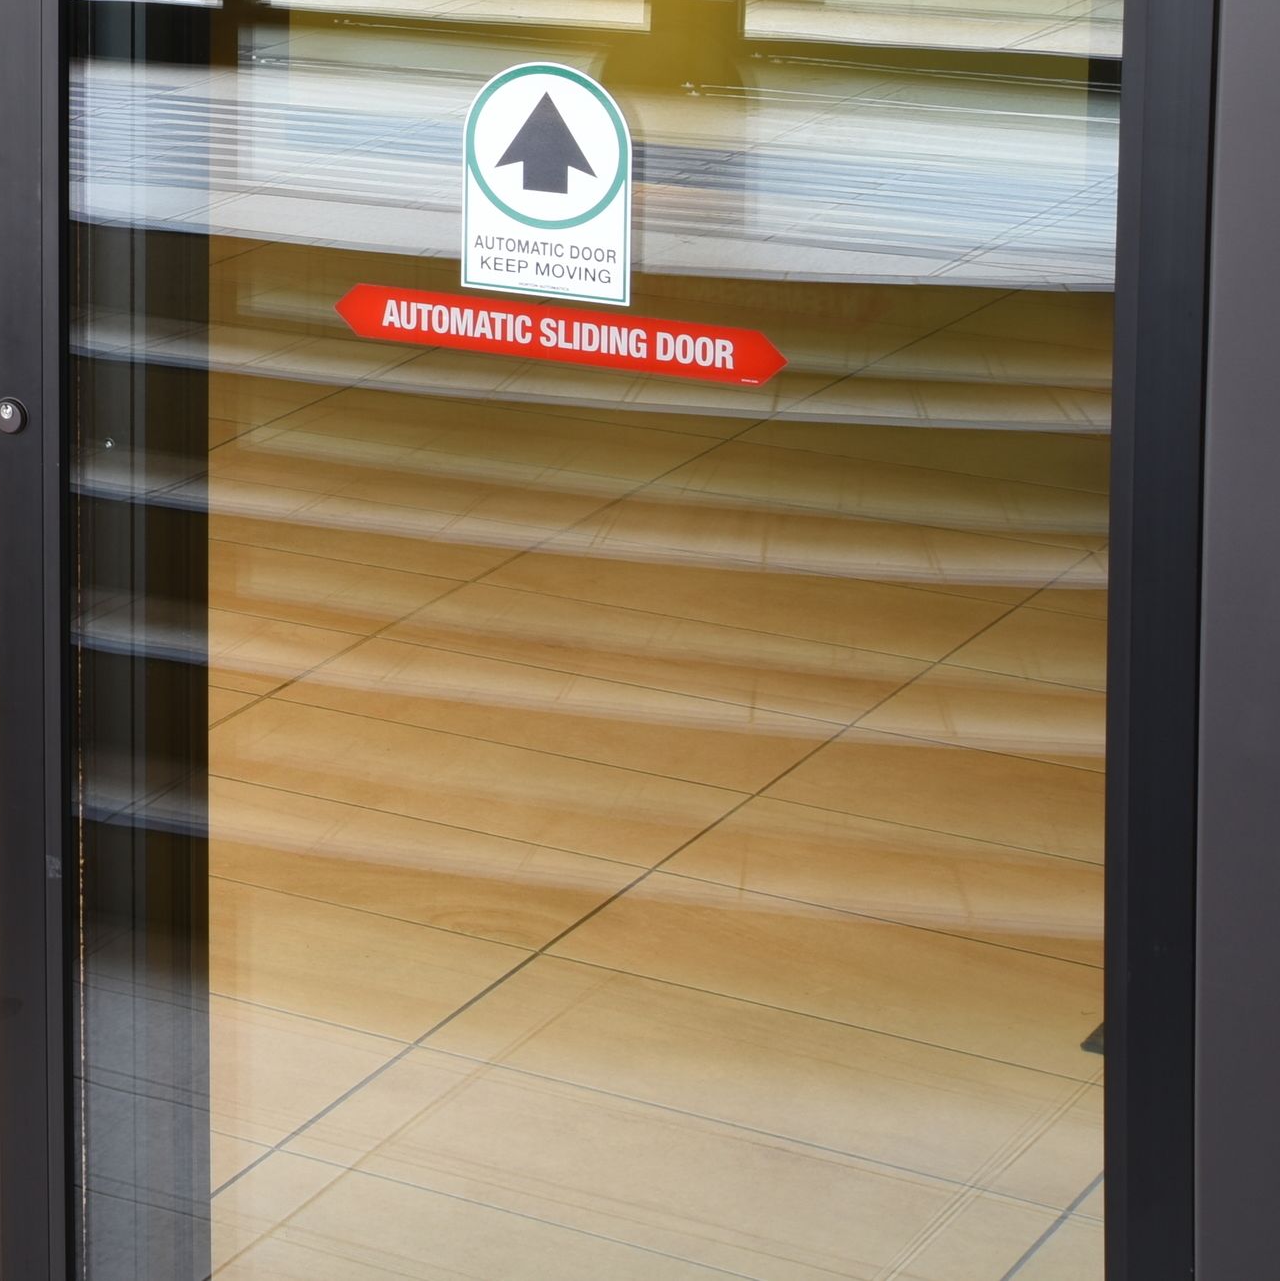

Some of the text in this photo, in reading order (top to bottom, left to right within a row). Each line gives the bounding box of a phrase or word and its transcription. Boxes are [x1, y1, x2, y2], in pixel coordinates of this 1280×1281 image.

[474, 235, 617, 264] AUTOMATIC DOOR
[480, 255, 611, 284] KEEP MOVING
[382, 299, 734, 370] AUTOMATIC SLIDING DOOR
